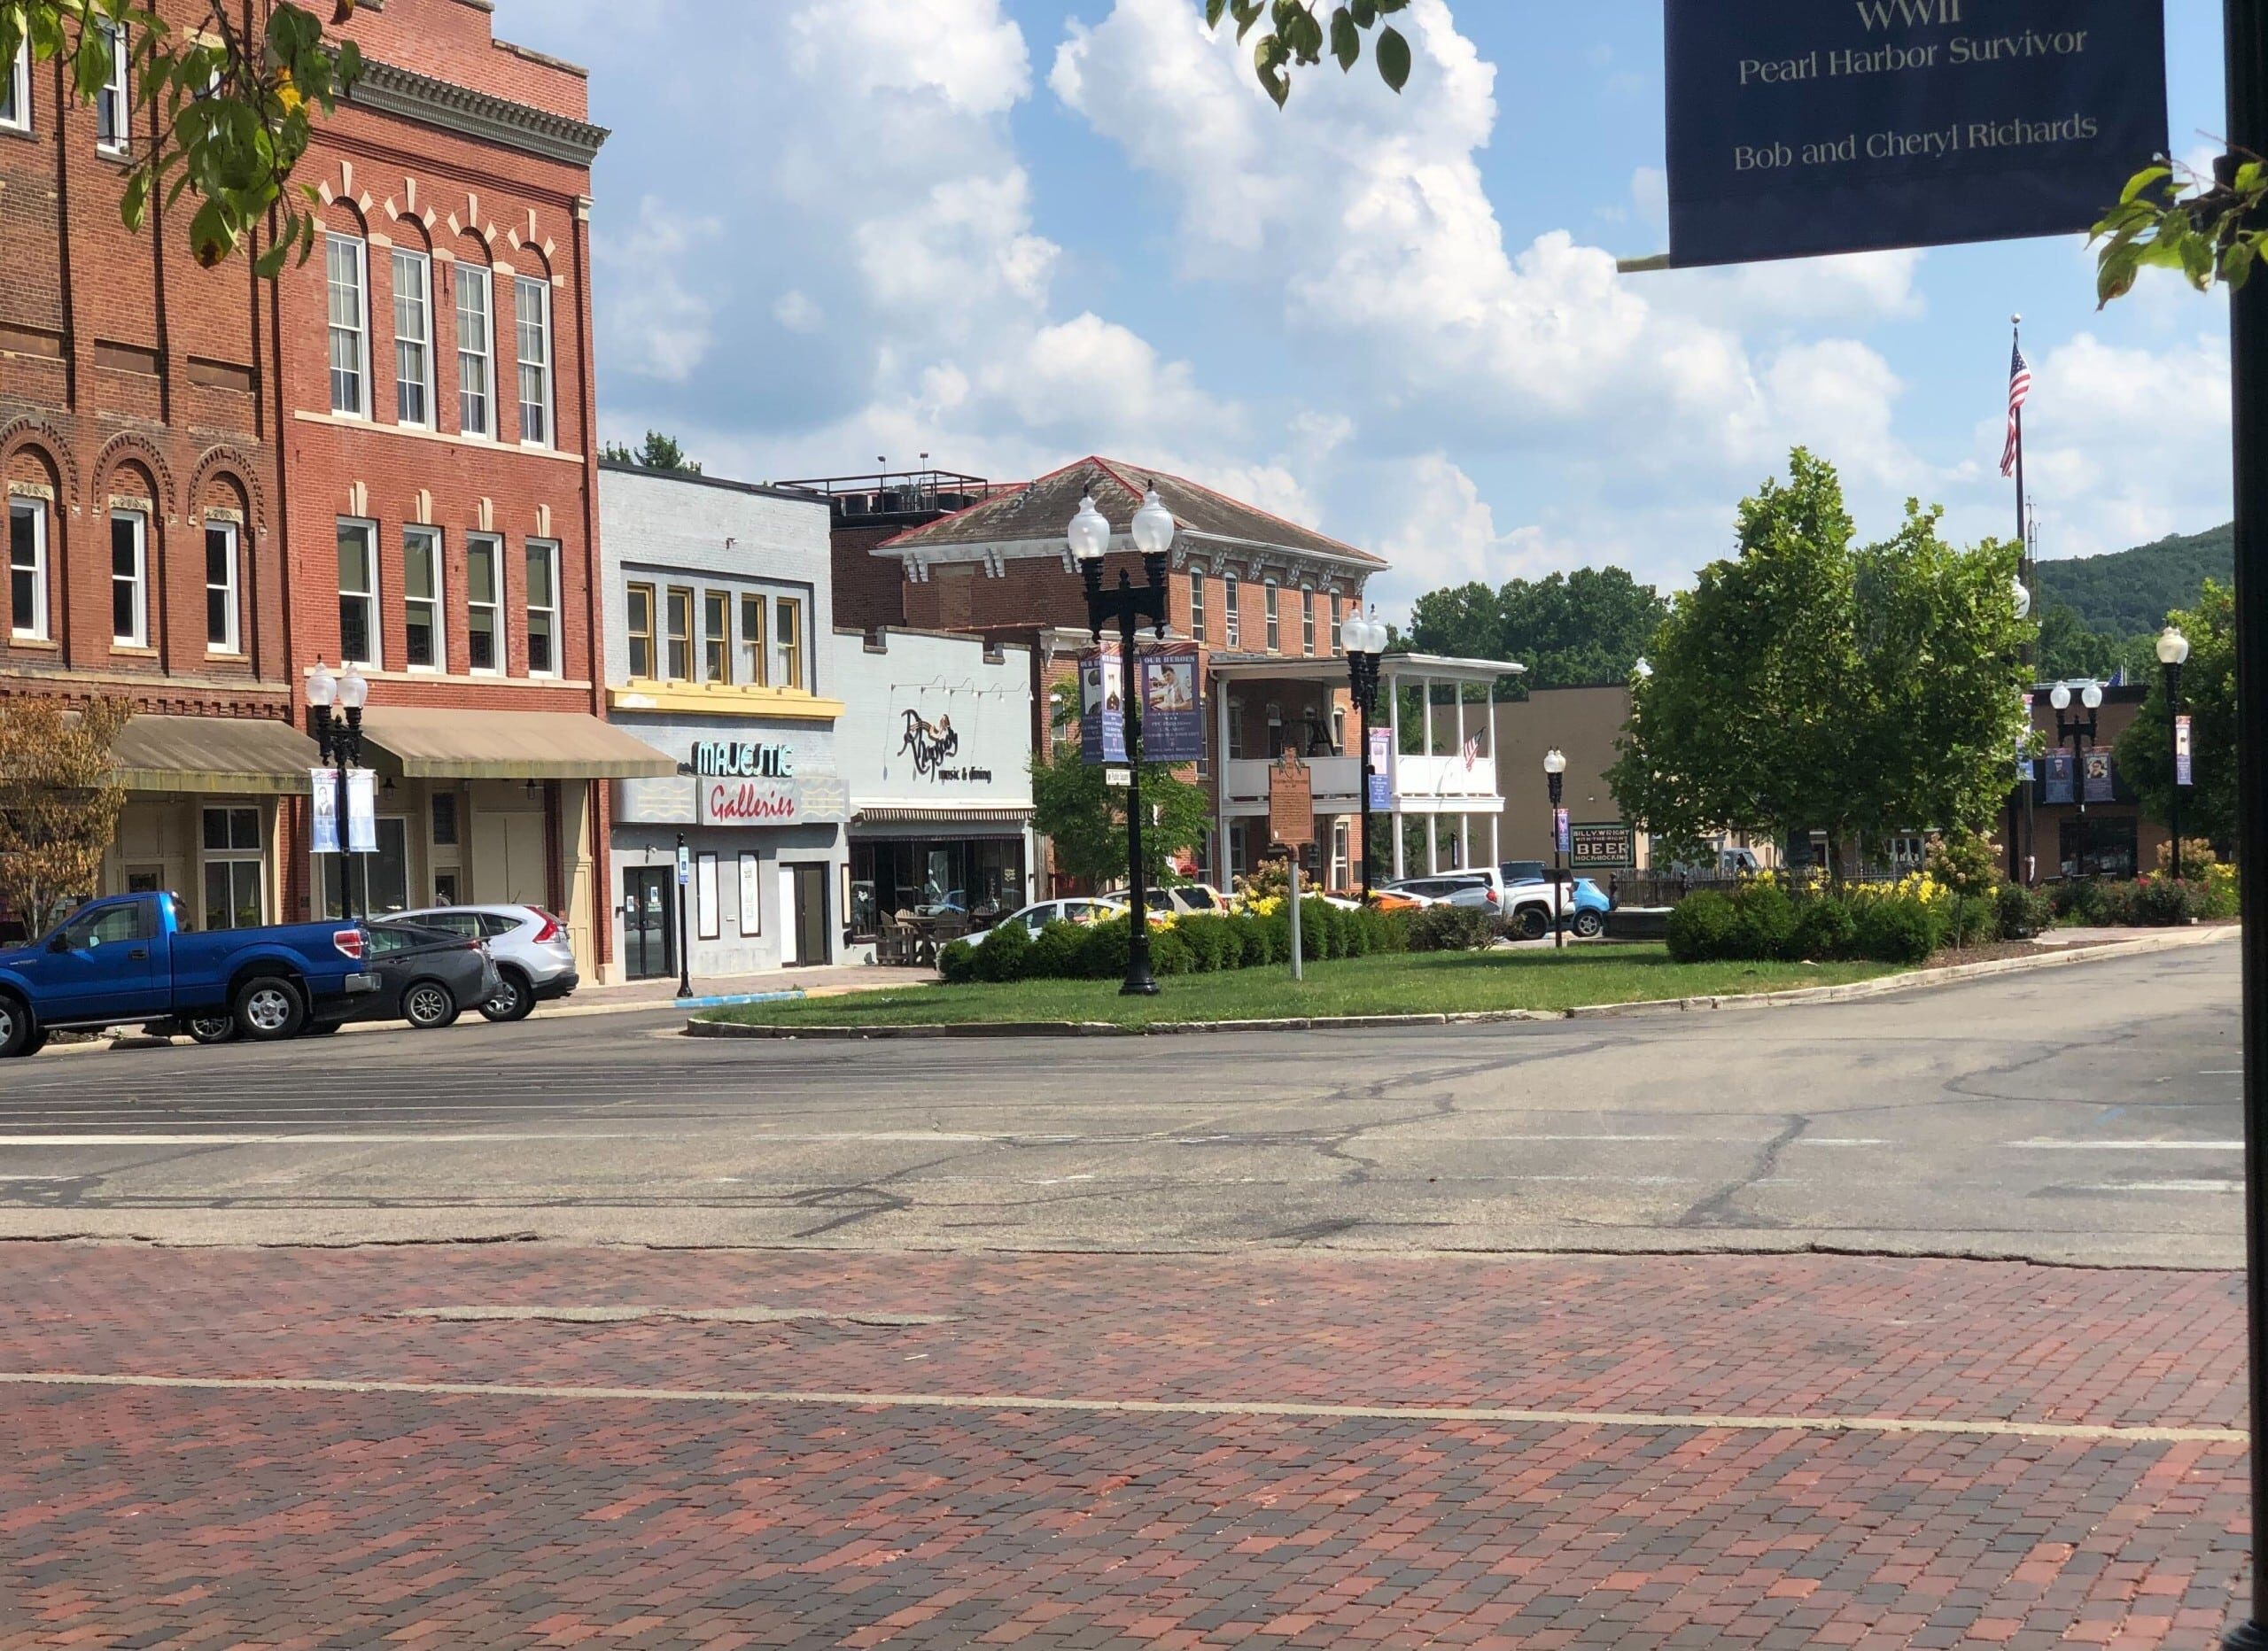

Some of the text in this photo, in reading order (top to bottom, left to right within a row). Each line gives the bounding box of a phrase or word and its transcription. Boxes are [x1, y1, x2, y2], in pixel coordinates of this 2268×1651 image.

[1856, 0, 1961, 32] WWII
[1738, 29, 2088, 85] Pearl Harbor Survivor
[1734, 112, 2099, 171] Bob and Cheryl Richards
[696, 740, 795, 776] MAJESTIC
[711, 783, 795, 822] Galleries
[1577, 842, 1629, 855] BEER
